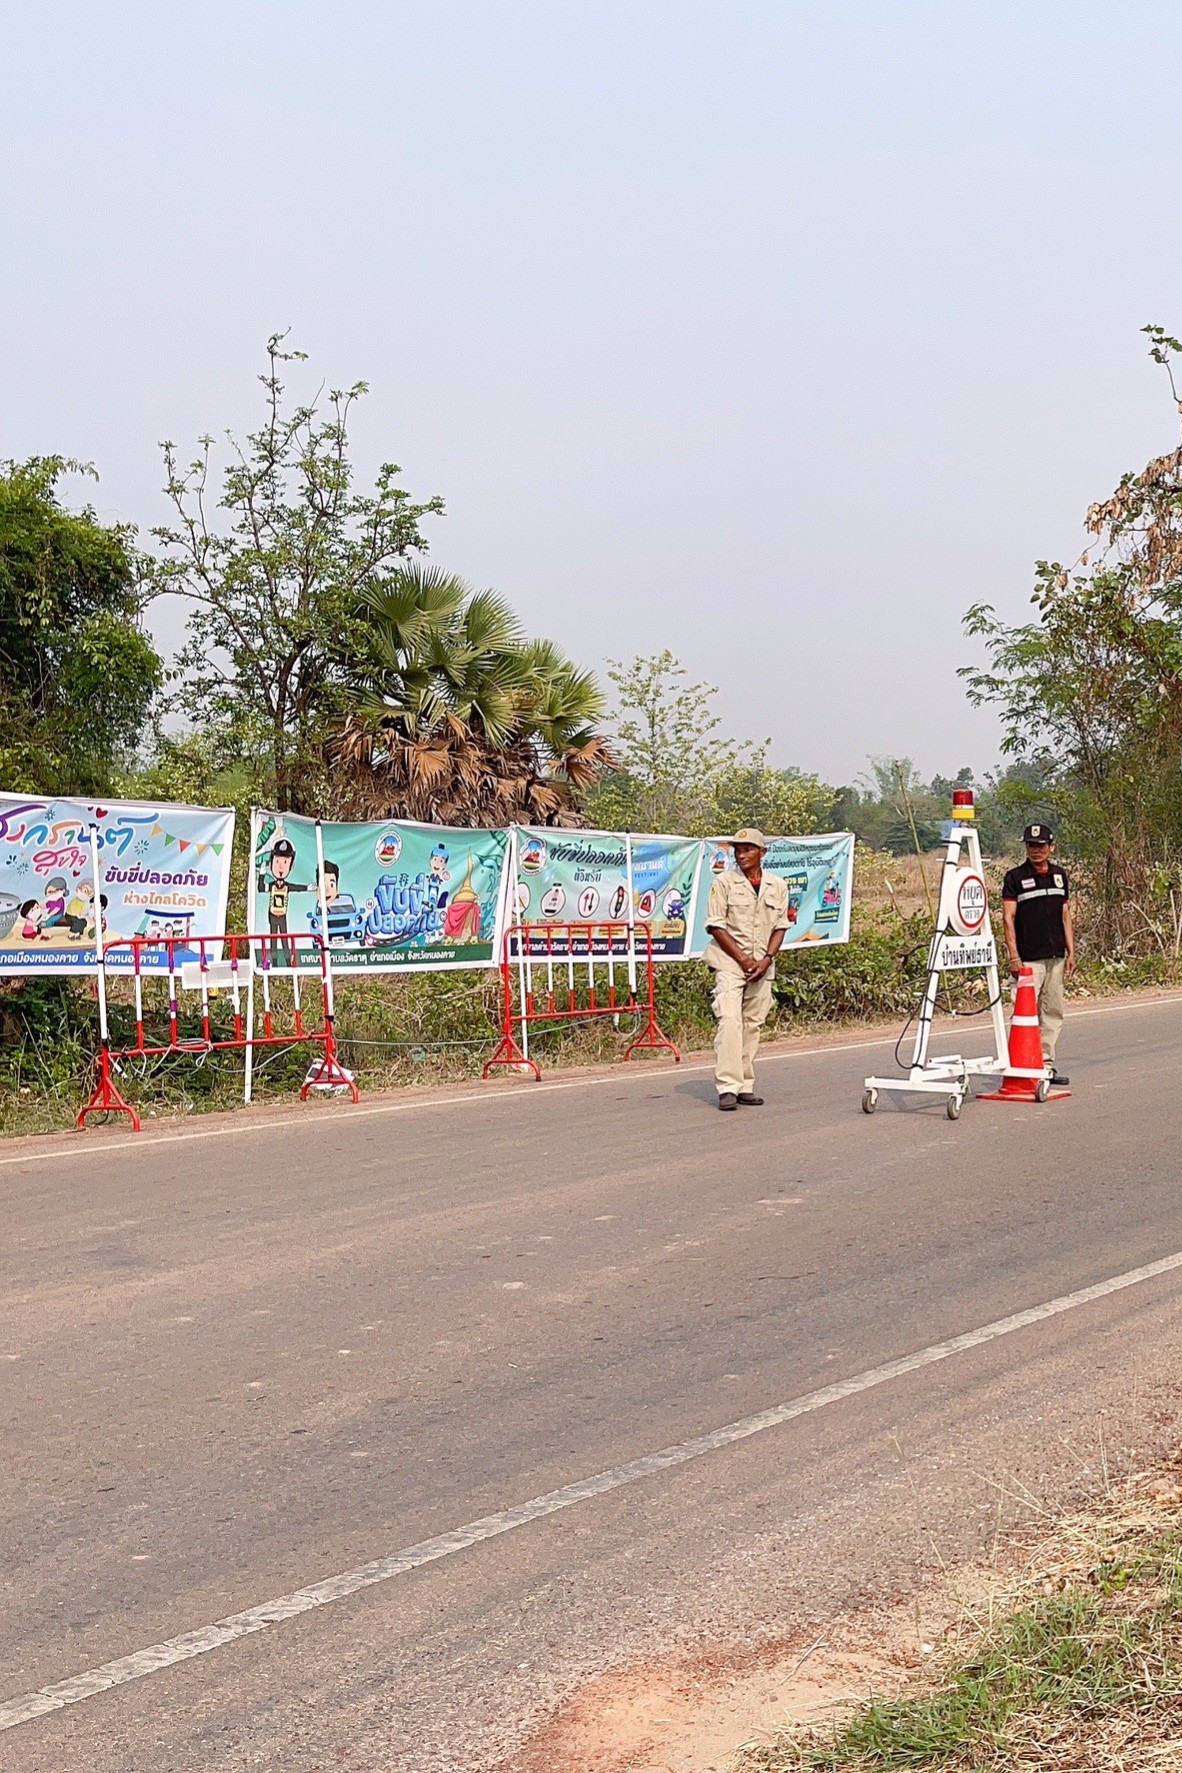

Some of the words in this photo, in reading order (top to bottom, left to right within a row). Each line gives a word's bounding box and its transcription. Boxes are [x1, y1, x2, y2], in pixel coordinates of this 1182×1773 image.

[33, 847, 87, 876] สุขใจ
[104, 862, 208, 887] ขับขี่ปลอดภัย
[123, 892, 207, 908] ห่างไกลโควิด
[962, 885, 983, 905] หยุด
